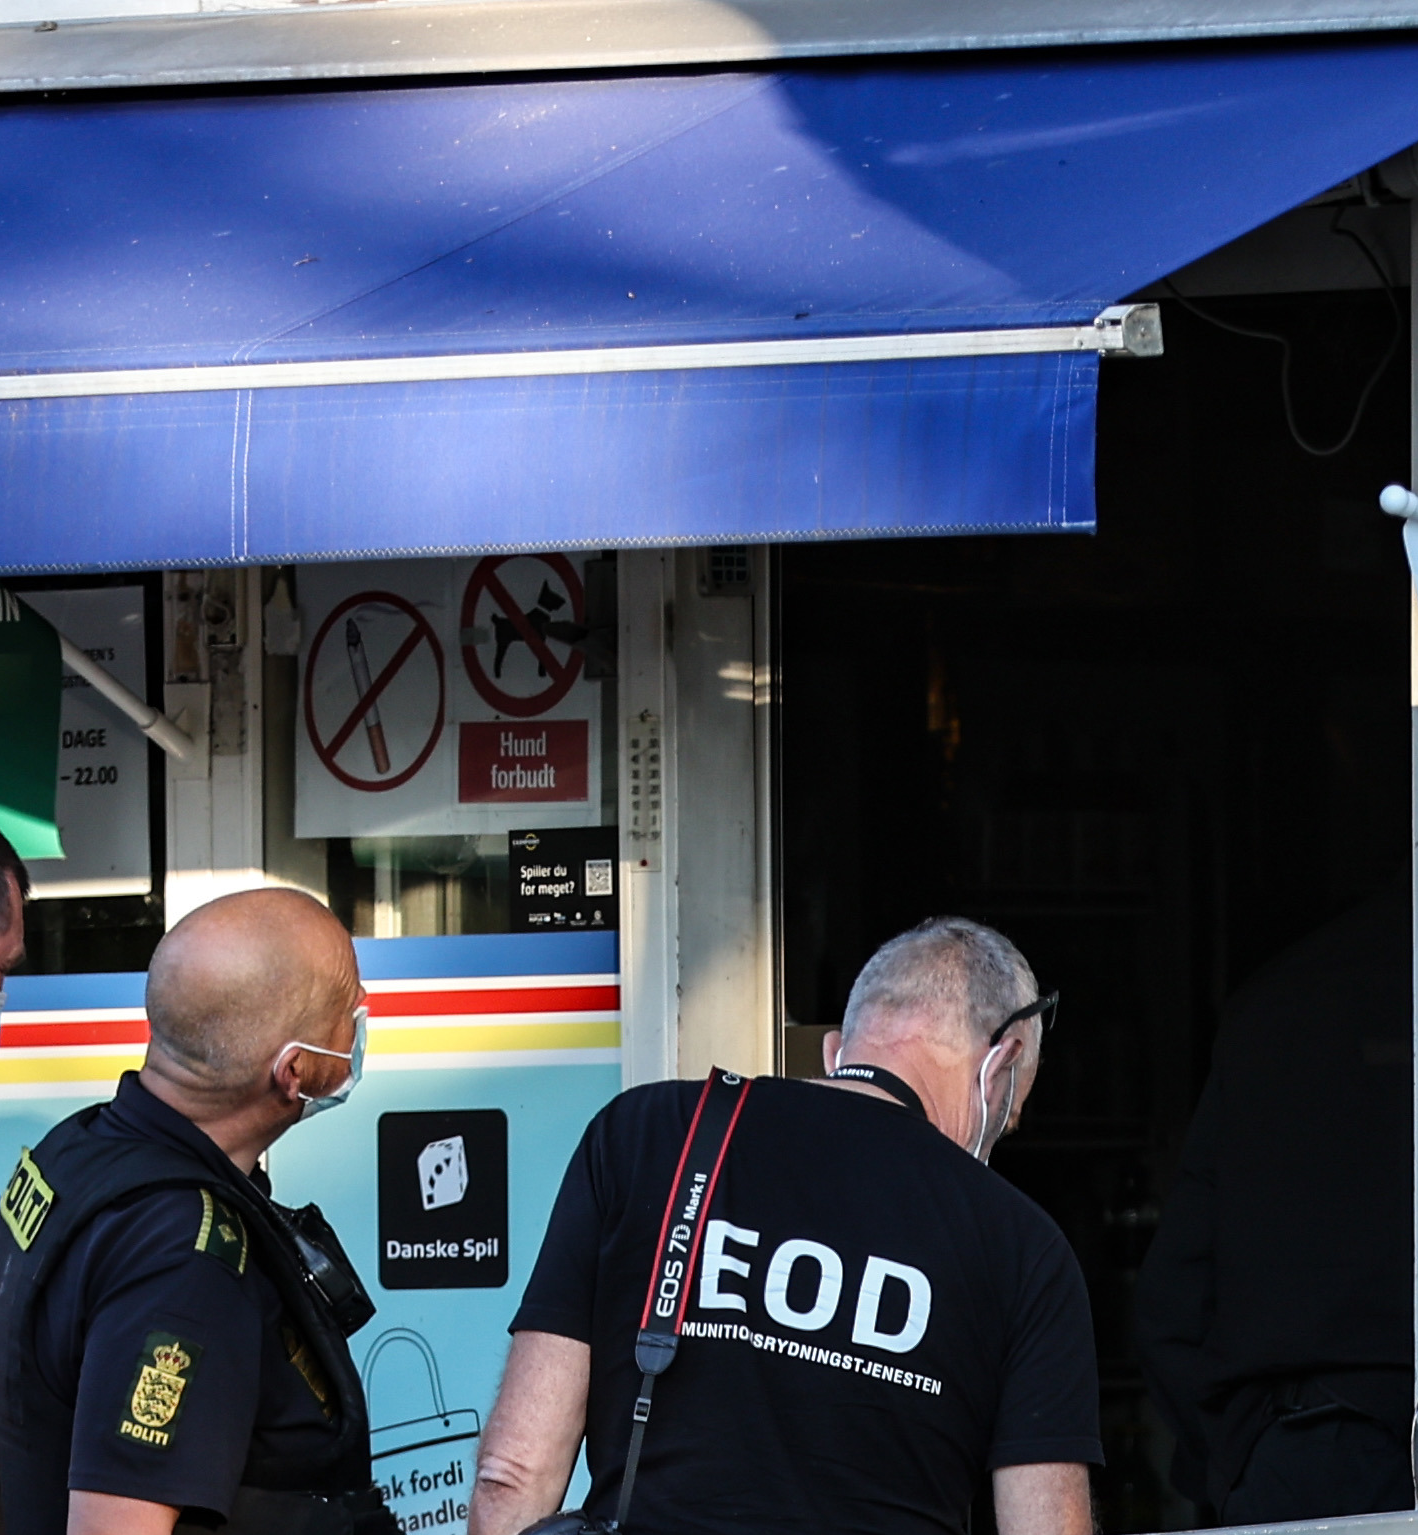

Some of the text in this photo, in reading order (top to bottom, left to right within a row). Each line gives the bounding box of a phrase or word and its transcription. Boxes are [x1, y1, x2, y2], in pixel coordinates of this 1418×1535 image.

[62, 729, 106, 749] DAGE
[499, 731, 547, 757] Hund
[74, 766, 118, 785] 22.00
[491, 764, 556, 789] forbudt
[520, 864, 568, 879] Spiller du
[520, 882, 575, 898] for meget?
[683, 1186, 704, 1221] Mark
[386, 1235, 499, 1262] Danske Spil
[668, 1224, 691, 1254] 7D
[656, 1260, 683, 1318] EOS
[699, 1218, 932, 1354] EOD
[681, 1321, 942, 1396] MUNITIOSRYDNINGSTJENESTEN
[120, 1420, 169, 1446] POLITI
[375, 1460, 464, 1501] ak fordi
